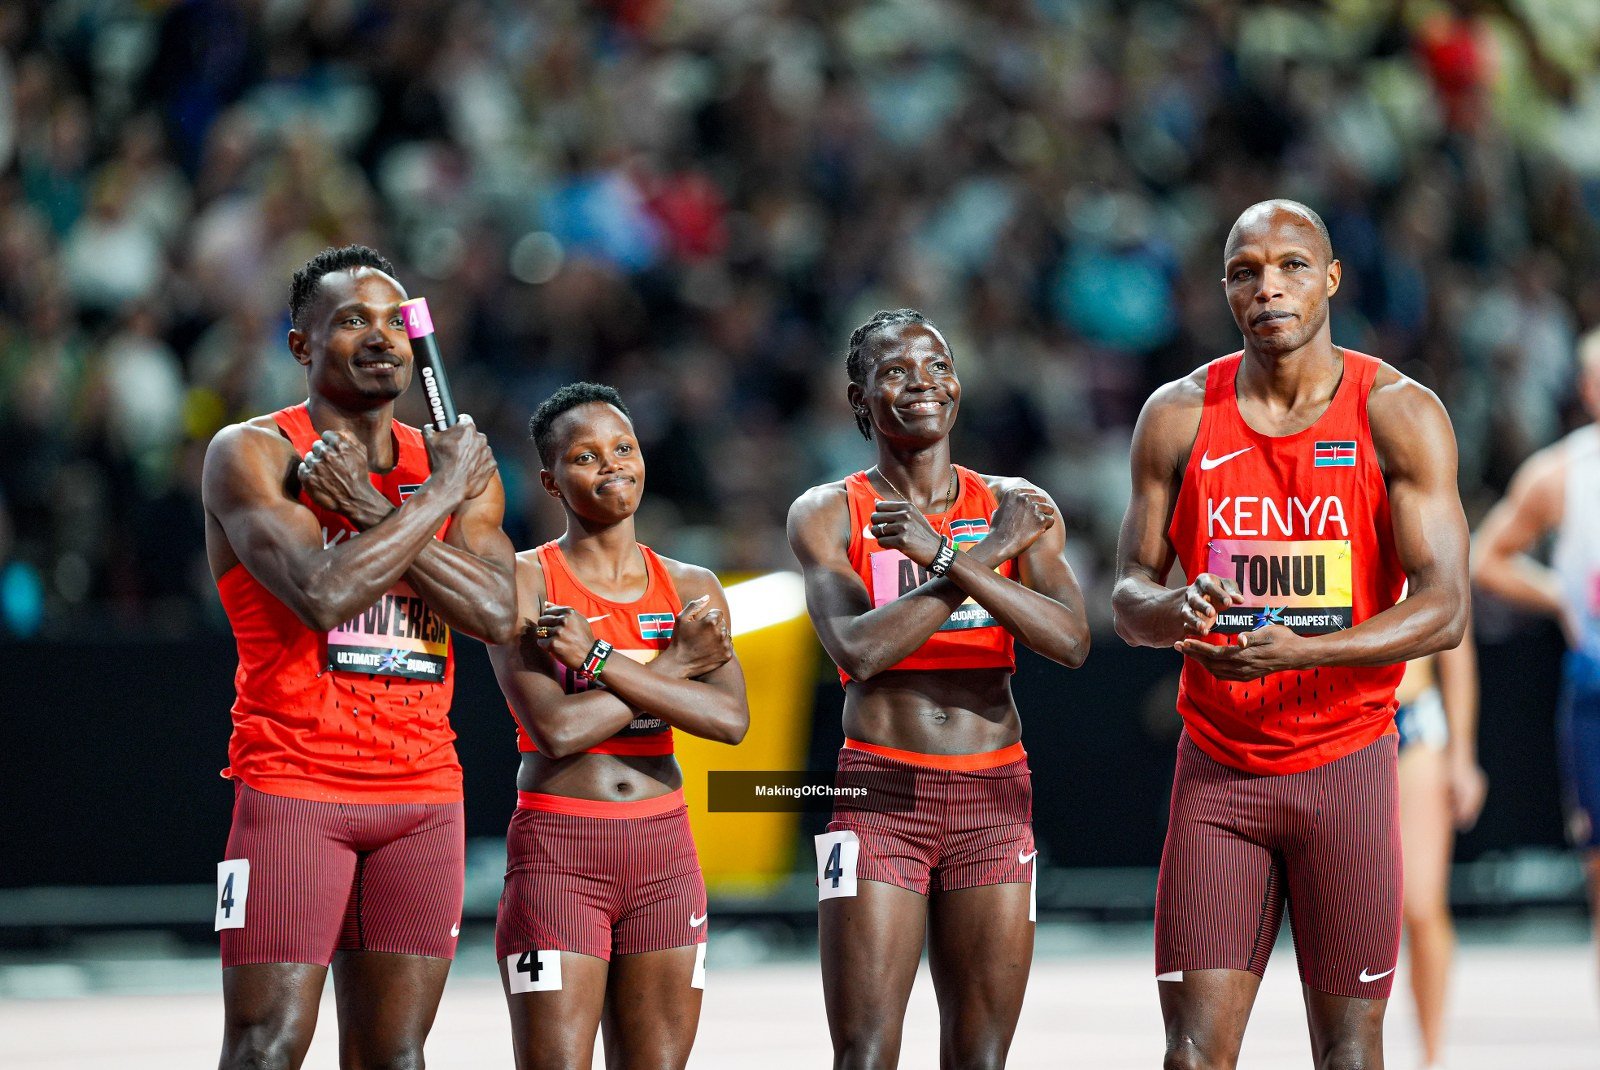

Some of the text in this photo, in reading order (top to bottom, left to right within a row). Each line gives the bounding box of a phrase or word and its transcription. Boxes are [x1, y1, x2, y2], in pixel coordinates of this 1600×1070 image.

[409, 307, 420, 329] 4
[422, 366, 446, 422] MONDO
[1207, 495, 1348, 537] KENYA
[1231, 554, 1326, 596] TONUI
[950, 609, 989, 622] BUDAPEST
[1215, 614, 1254, 626] ULTIMATE
[1283, 615, 1330, 627] BUDAPEST
[337, 651, 381, 667] ULTIMATE
[825, 842, 843, 889] 4
[221, 872, 235, 919] 4
[516, 950, 544, 983] 4
